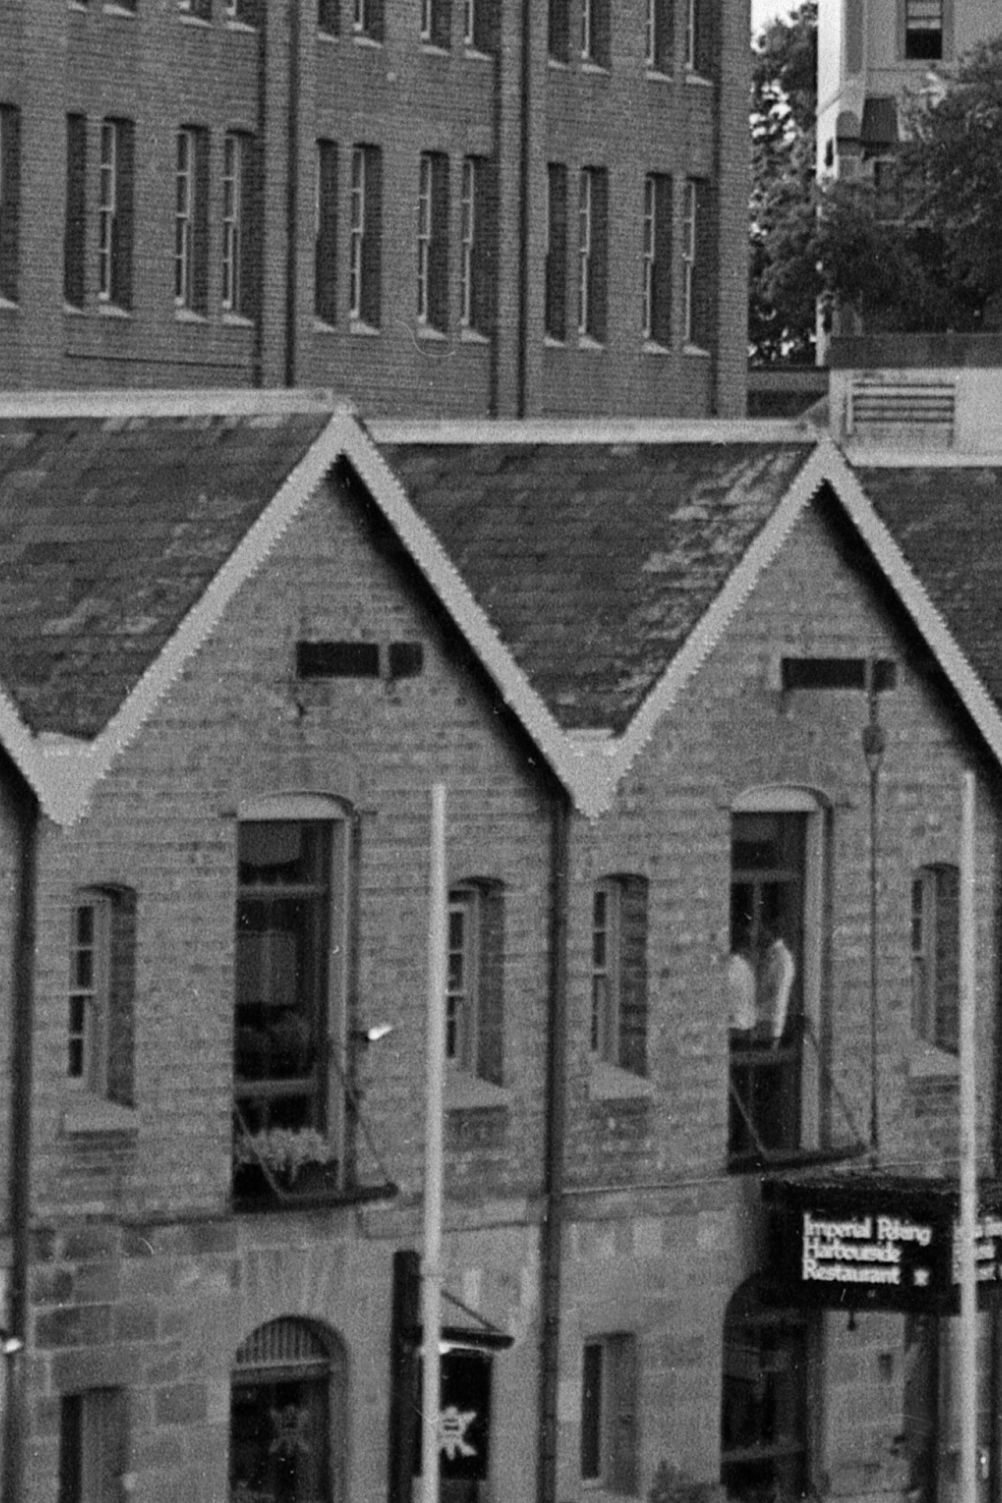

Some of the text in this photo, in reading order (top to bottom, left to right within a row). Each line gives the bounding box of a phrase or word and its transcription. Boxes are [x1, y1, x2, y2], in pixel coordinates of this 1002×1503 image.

[803, 1213, 871, 1243] Imperial
[877, 1214, 932, 1247] Peking
[803, 1237, 901, 1263] Harbourside
[802, 1258, 900, 1285] Restaurant
